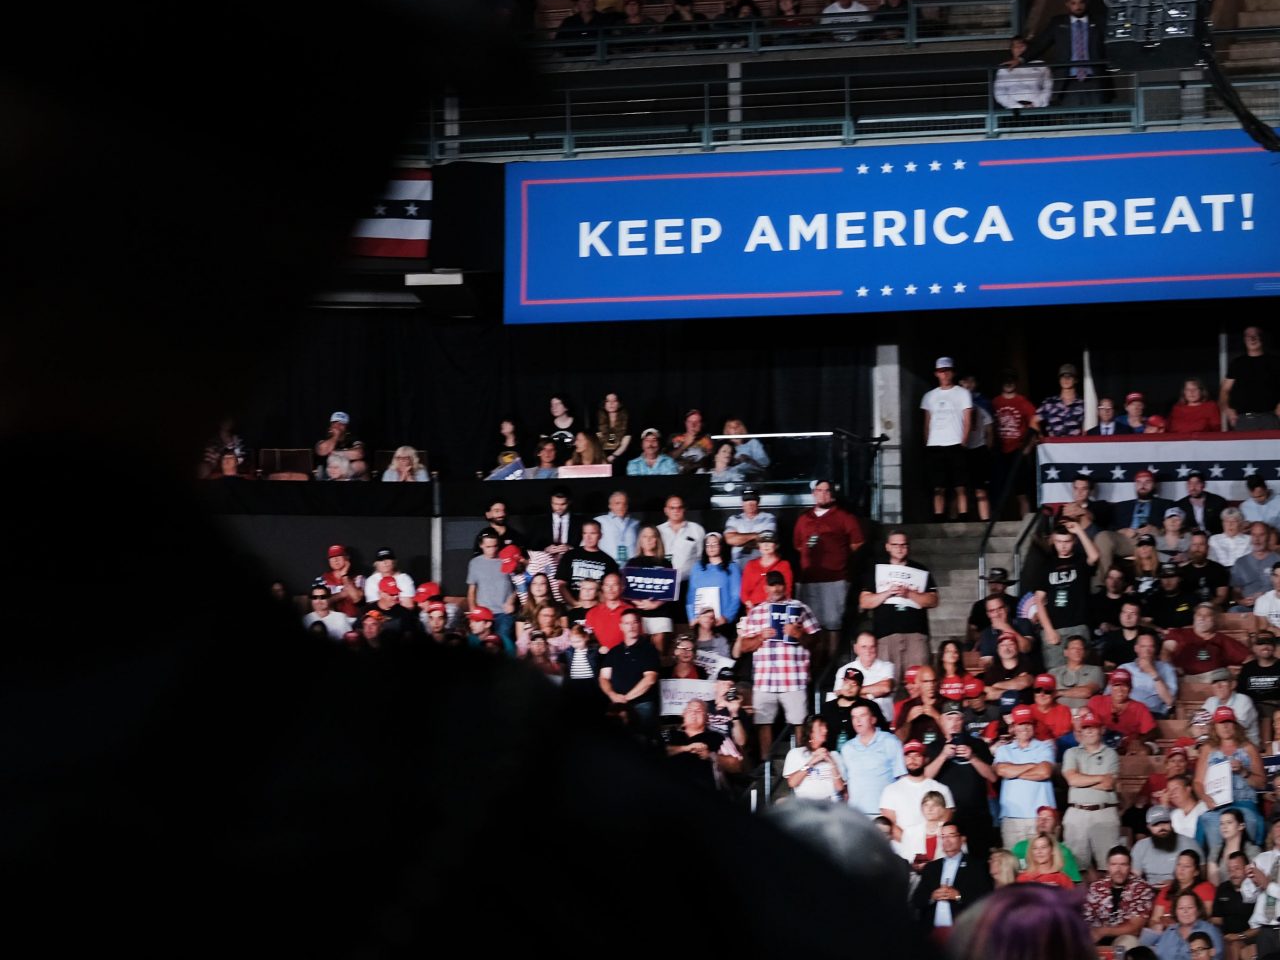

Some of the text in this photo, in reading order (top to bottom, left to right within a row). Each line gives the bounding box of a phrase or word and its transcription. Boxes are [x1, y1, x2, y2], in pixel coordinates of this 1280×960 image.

[578, 193, 1254, 258] KEEP AMERICA GREAT!
[626, 576, 674, 585] TRUMP
